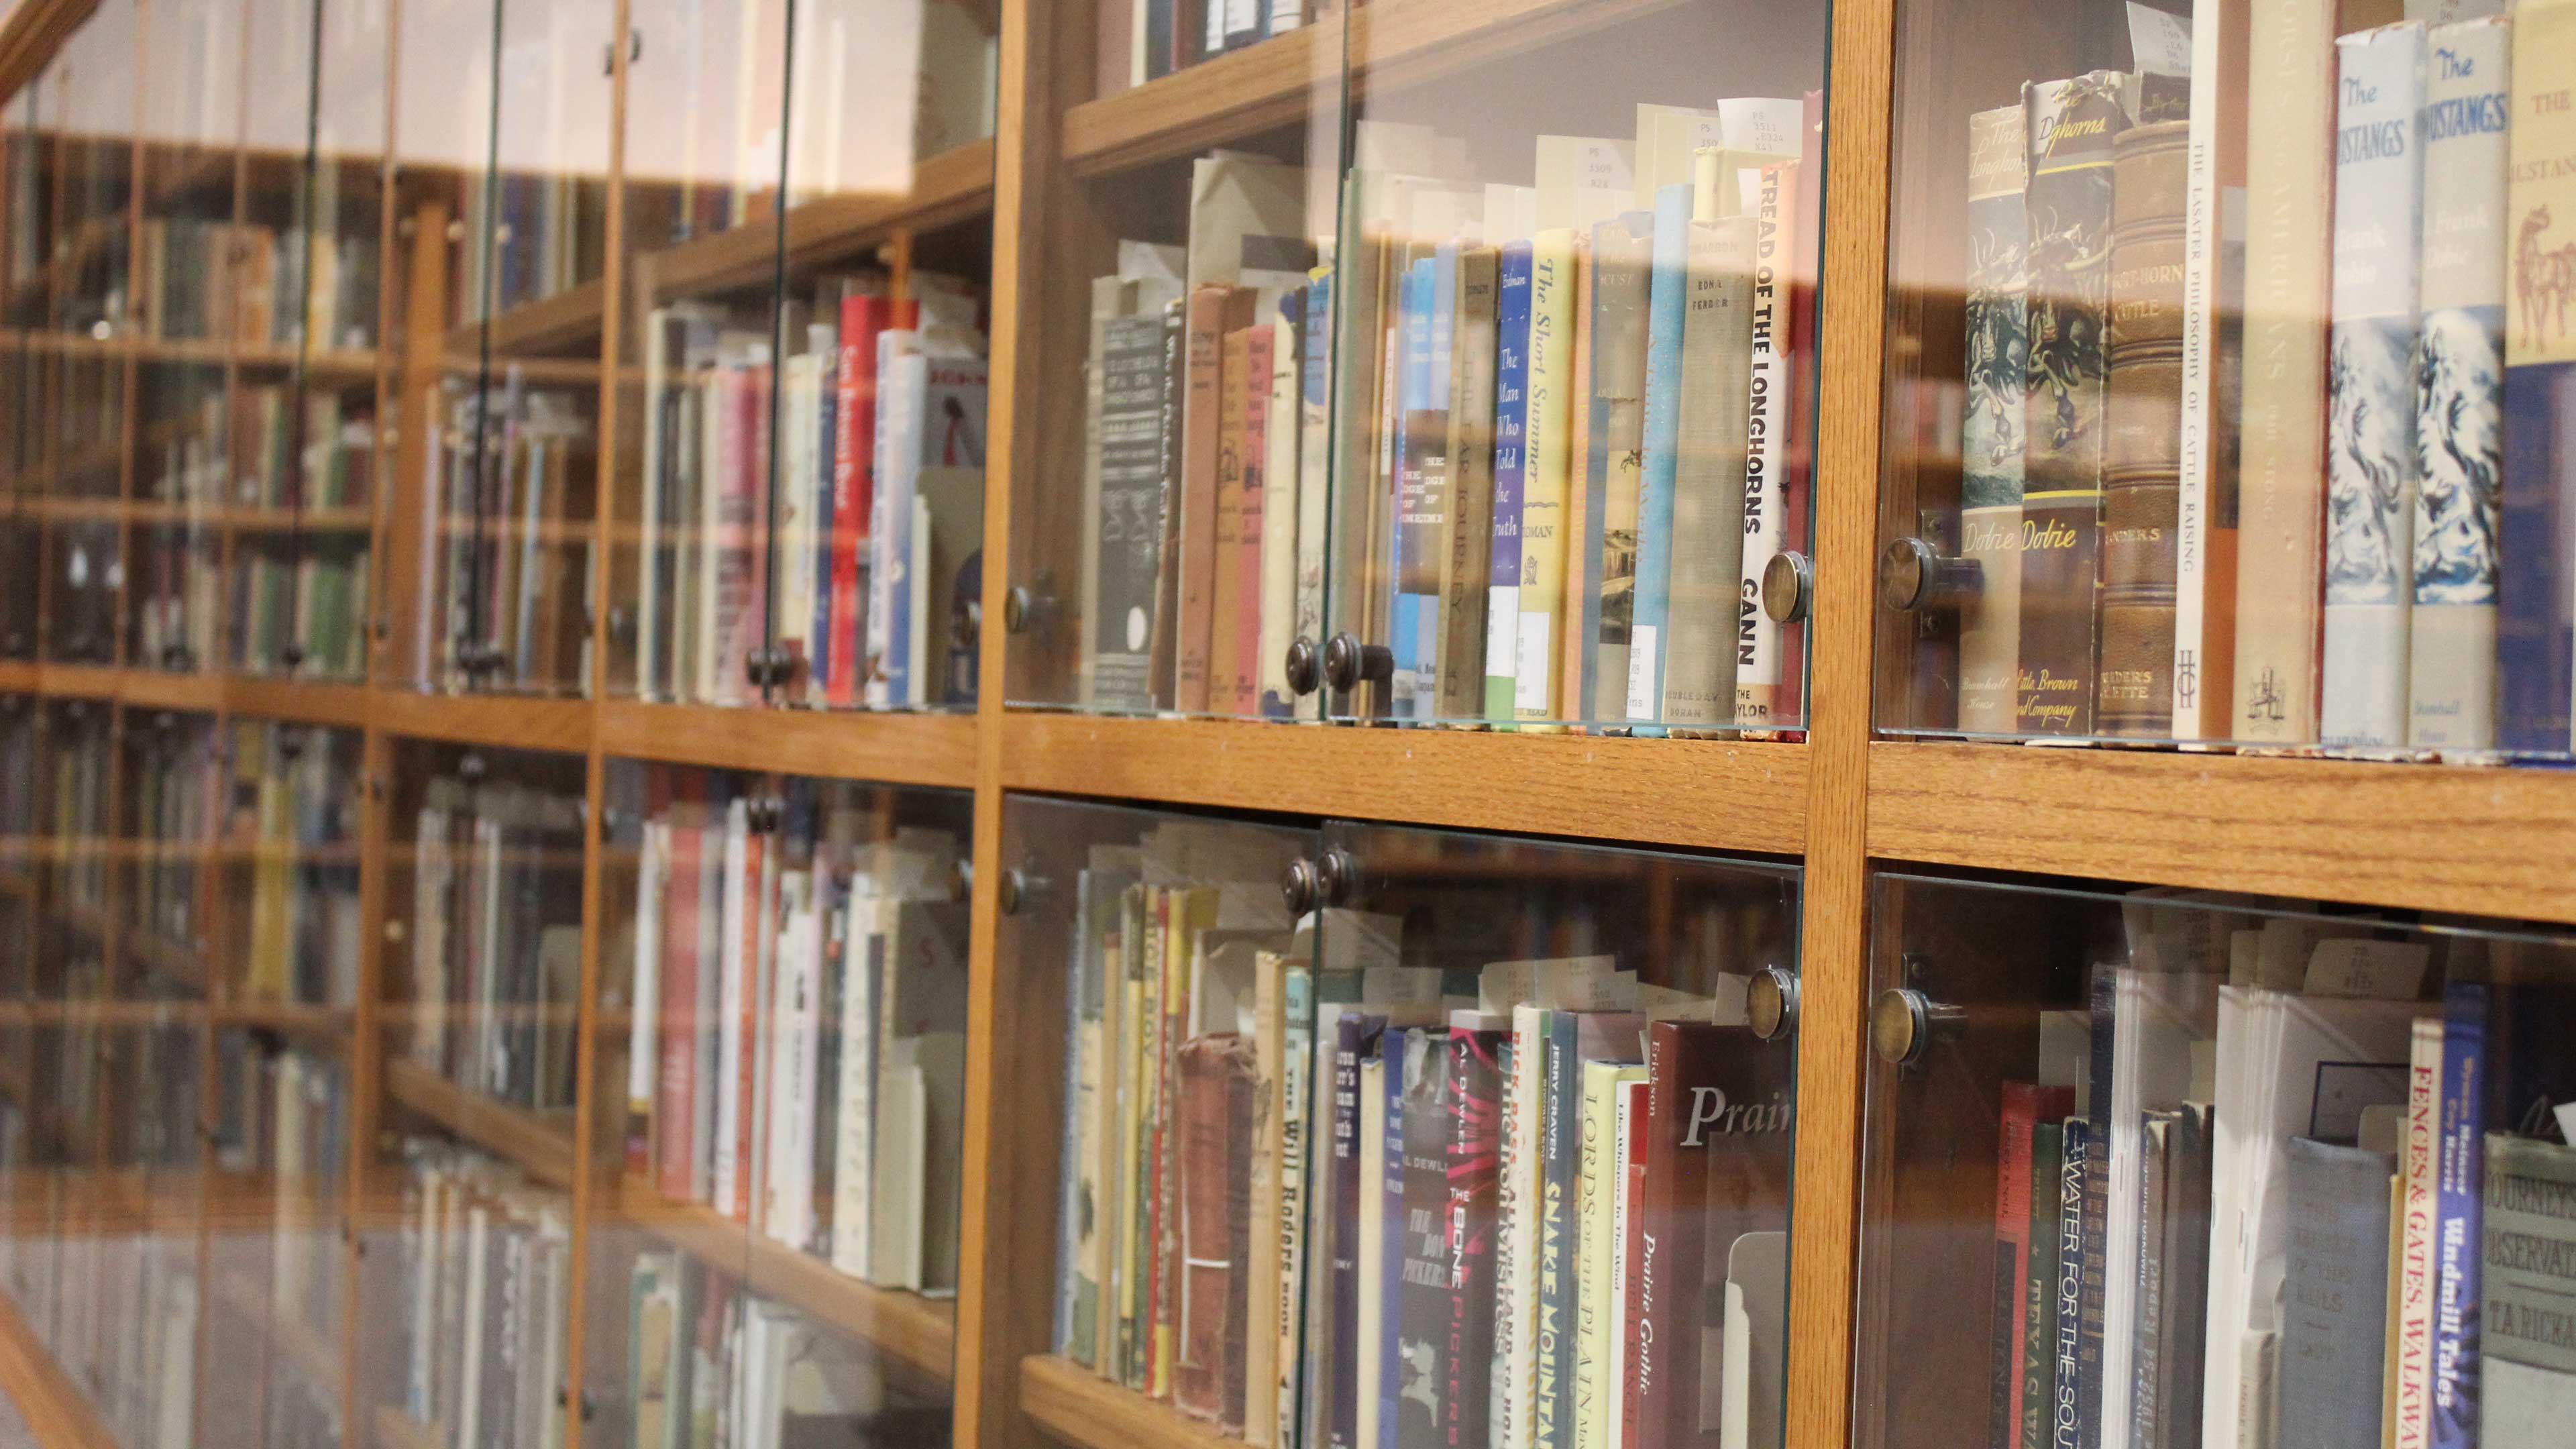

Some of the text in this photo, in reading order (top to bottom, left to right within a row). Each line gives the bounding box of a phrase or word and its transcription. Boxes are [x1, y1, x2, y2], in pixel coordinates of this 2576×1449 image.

[2435, 47, 2475, 80] The
[2343, 76, 2378, 108] The
[2530, 89, 2571, 115] THE
[1991, 121, 2020, 145] The
[2426, 93, 2509, 142] USTANGS
[2337, 119, 2405, 166] USTANGS
[1502, 274, 1526, 288] Erdman
[1501, 347, 1519, 370] The
[1527, 258, 1554, 483] The Short Summer
[2183, 142, 2205, 574] THE LASATER PHILOSOPHY OF CATTLE RAISING
[1498, 382, 1519, 403] Man
[1497, 415, 1519, 437] Who
[1737, 170, 1779, 667] TREAD OF THE LONGHORNS GANN
[1495, 448, 1516, 470] Told
[1495, 481, 1509, 504] the
[1962, 522, 2015, 554] Dobie
[2021, 518, 2078, 552] Dobie
[1737, 689, 1751, 699] THE
[1962, 676, 2010, 692] Bramhall
[2038, 668, 2078, 692] Brown
[2027, 695, 2077, 728] Company
[1511, 1030, 1521, 1090] RICK
[1549, 1043, 1561, 1093] JERRY
[1457, 1043, 1468, 1155] AL DEWLEN
[1508, 1100, 1520, 1164] BASS
[1548, 1095, 1560, 1161] CRAVEN
[2410, 1065, 2432, 1182] FENCES
[1582, 1093, 1599, 1217] LORDS
[1615, 1138, 1624, 1202] Whispers
[1279, 1069, 1300, 1336] THE Will Rogers BOOK
[1449, 1186, 1471, 1203] THE
[1507, 1187, 1517, 1232] ALL
[1615, 1205, 1621, 1220] In
[2408, 1183, 2428, 1205] &
[1542, 1181, 1563, 1296] SNAKE
[1584, 1220, 1593, 1248] OF
[1615, 1224, 1623, 1251] The
[1640, 1040, 1661, 1395] Erickson Prairie Gothic
[1505, 1243, 1515, 1281] THE
[1581, 1254, 1593, 1300] THE
[1613, 1254, 1621, 1291] Wind
[2405, 1210, 2427, 1310] GATES,
[2057, 1161, 2082, 1449] WATER FOR THE SOU
[2144, 1258, 2159, 1336] Report
[2436, 1216, 2467, 1409] Windmill Tales
[1448, 1208, 1466, 1446] BONE PICKERS
[1503, 1287, 1515, 1355] LAND
[2023, 1279, 2043, 1397] TEXAS
[1503, 1362, 1513, 1389] TO
[1537, 1305, 1560, 1449] MOUNTA
[1577, 1305, 1595, 1418] PLAIN
